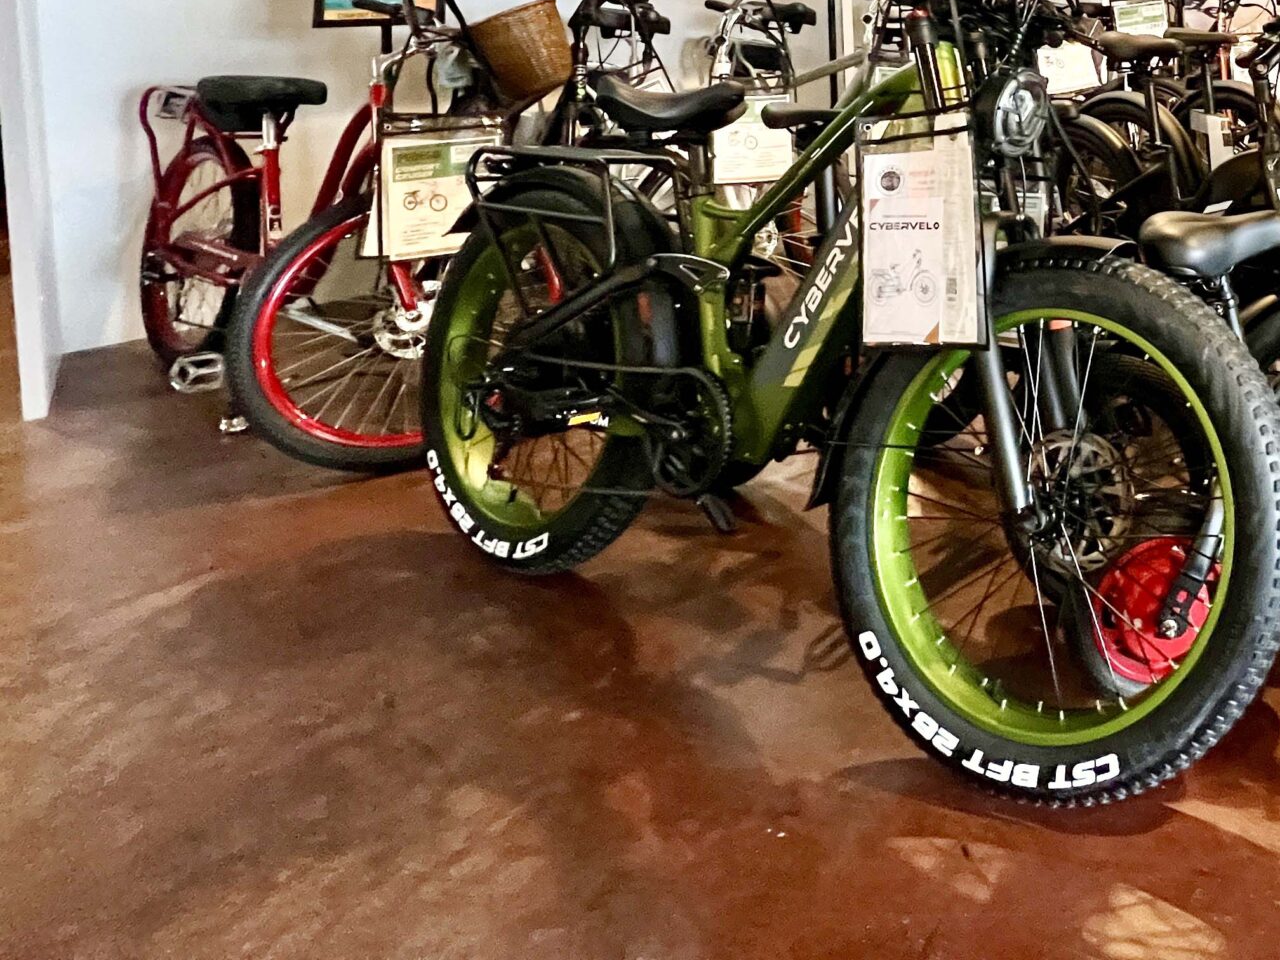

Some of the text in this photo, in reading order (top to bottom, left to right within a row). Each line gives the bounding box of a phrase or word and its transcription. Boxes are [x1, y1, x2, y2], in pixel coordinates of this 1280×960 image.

[869, 221, 941, 231] CYBERVELO
[783, 205, 859, 349] CYBERV
[471, 529, 511, 559] BFT
[512, 531, 550, 559] CST
[961, 748, 1041, 789] BFT
[1047, 753, 1121, 790] CST
